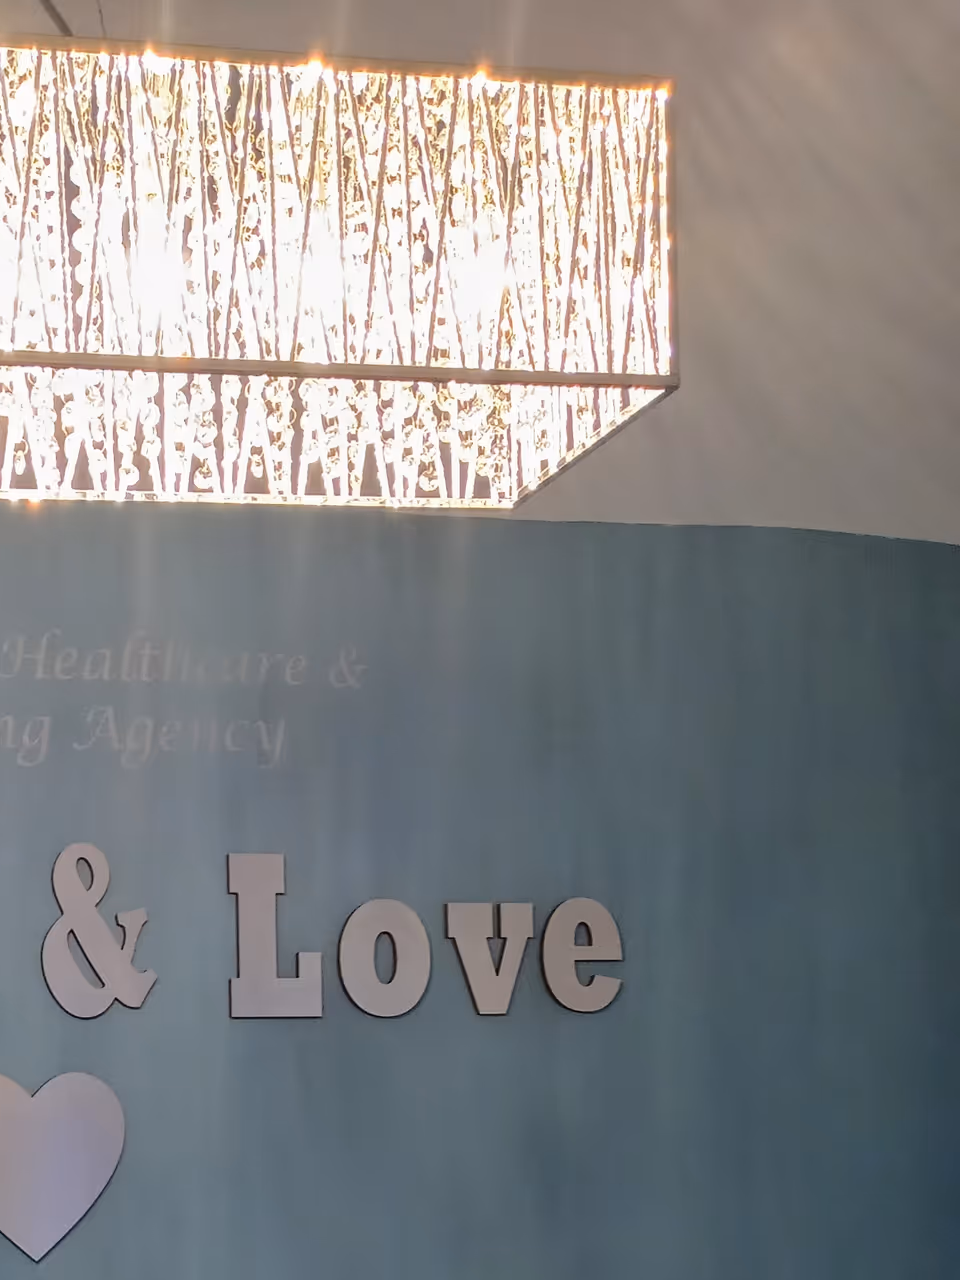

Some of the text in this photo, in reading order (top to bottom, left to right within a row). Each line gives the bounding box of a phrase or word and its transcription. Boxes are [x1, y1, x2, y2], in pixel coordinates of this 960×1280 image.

[327, 648, 368, 688] &
[73, 705, 286, 768] Agency
[40, 842, 159, 1020] &
[228, 852, 626, 1021] Love
